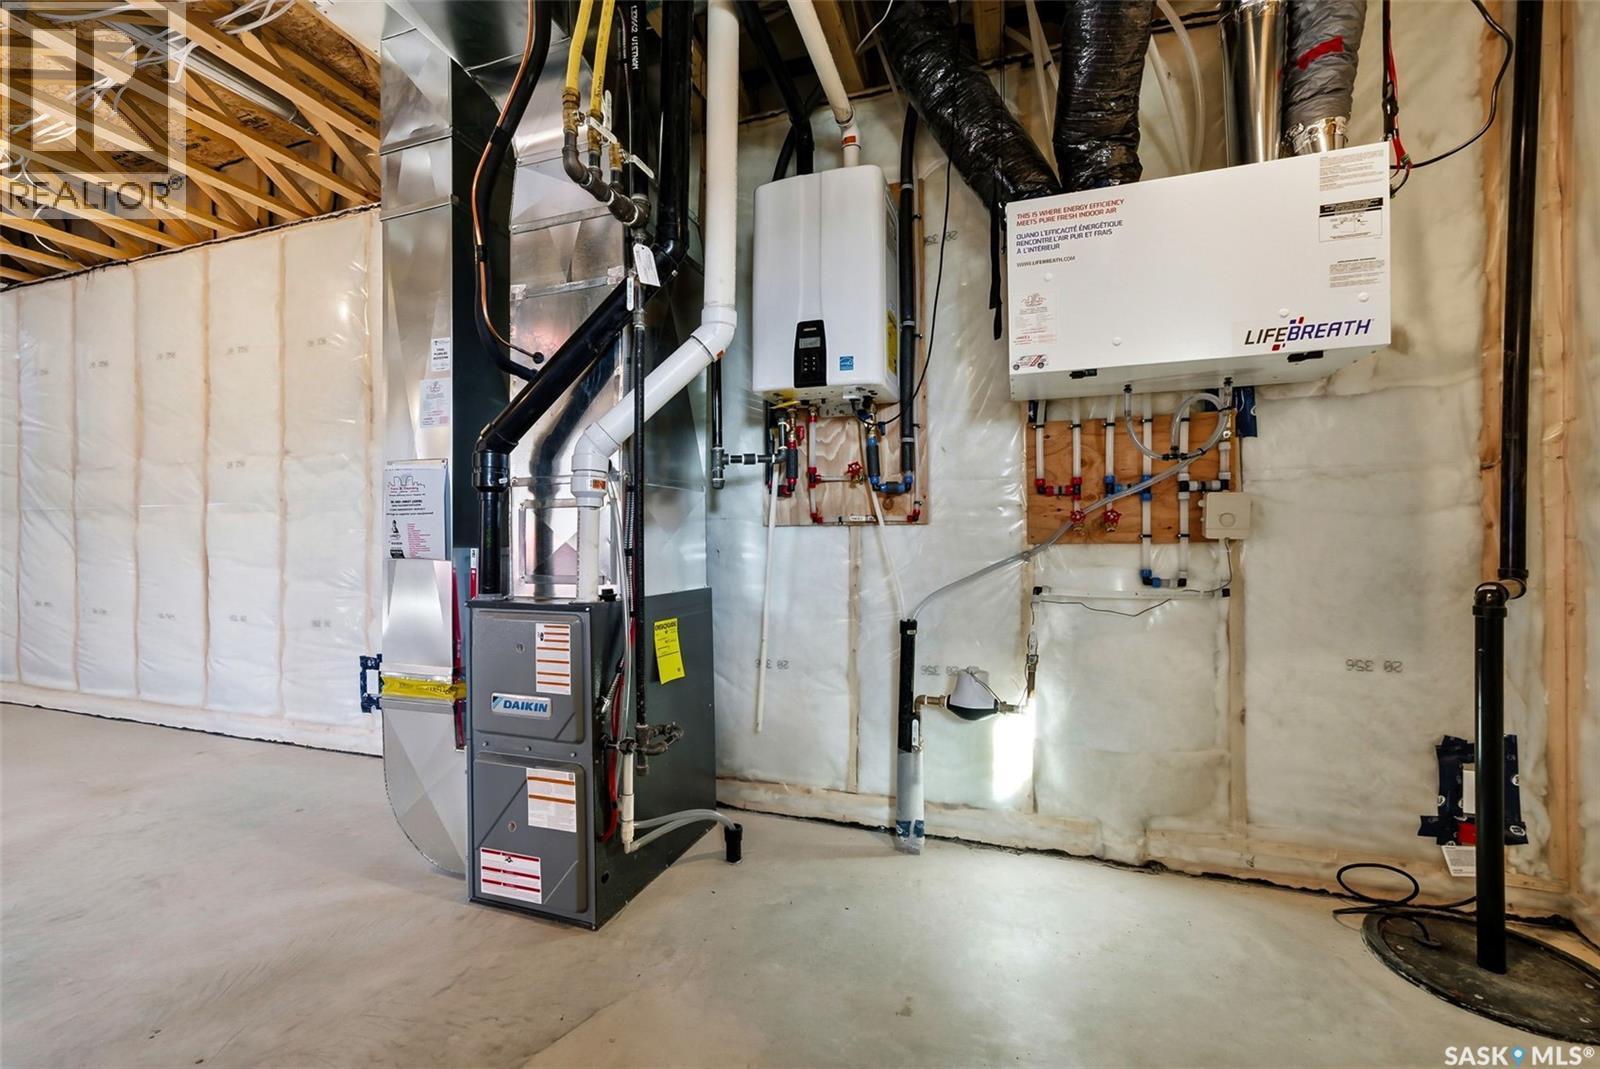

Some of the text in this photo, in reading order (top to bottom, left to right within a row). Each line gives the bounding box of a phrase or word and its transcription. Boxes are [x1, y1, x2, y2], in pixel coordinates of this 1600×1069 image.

[1016, 212, 1031, 220] THIS
[1039, 208, 1062, 217] WHERE
[1063, 204, 1088, 213] ENERGY
[1090, 199, 1125, 210] EFFICIENCY
[1016, 219, 1038, 227] MEETS
[1039, 216, 1056, 224] PURE
[1056, 214, 1077, 222] FRESH
[1078, 208, 1104, 218] INDOOR
[1016, 231, 1040, 240] QUAND
[1016, 236, 1053, 247] RENCONTRE
[1069, 232, 1083, 240] PUR
[1093, 229, 1113, 237] FRAIS
[1244, 318, 1372, 345] LIFEBREATH
[503, 700, 547, 713] DAIKIN
